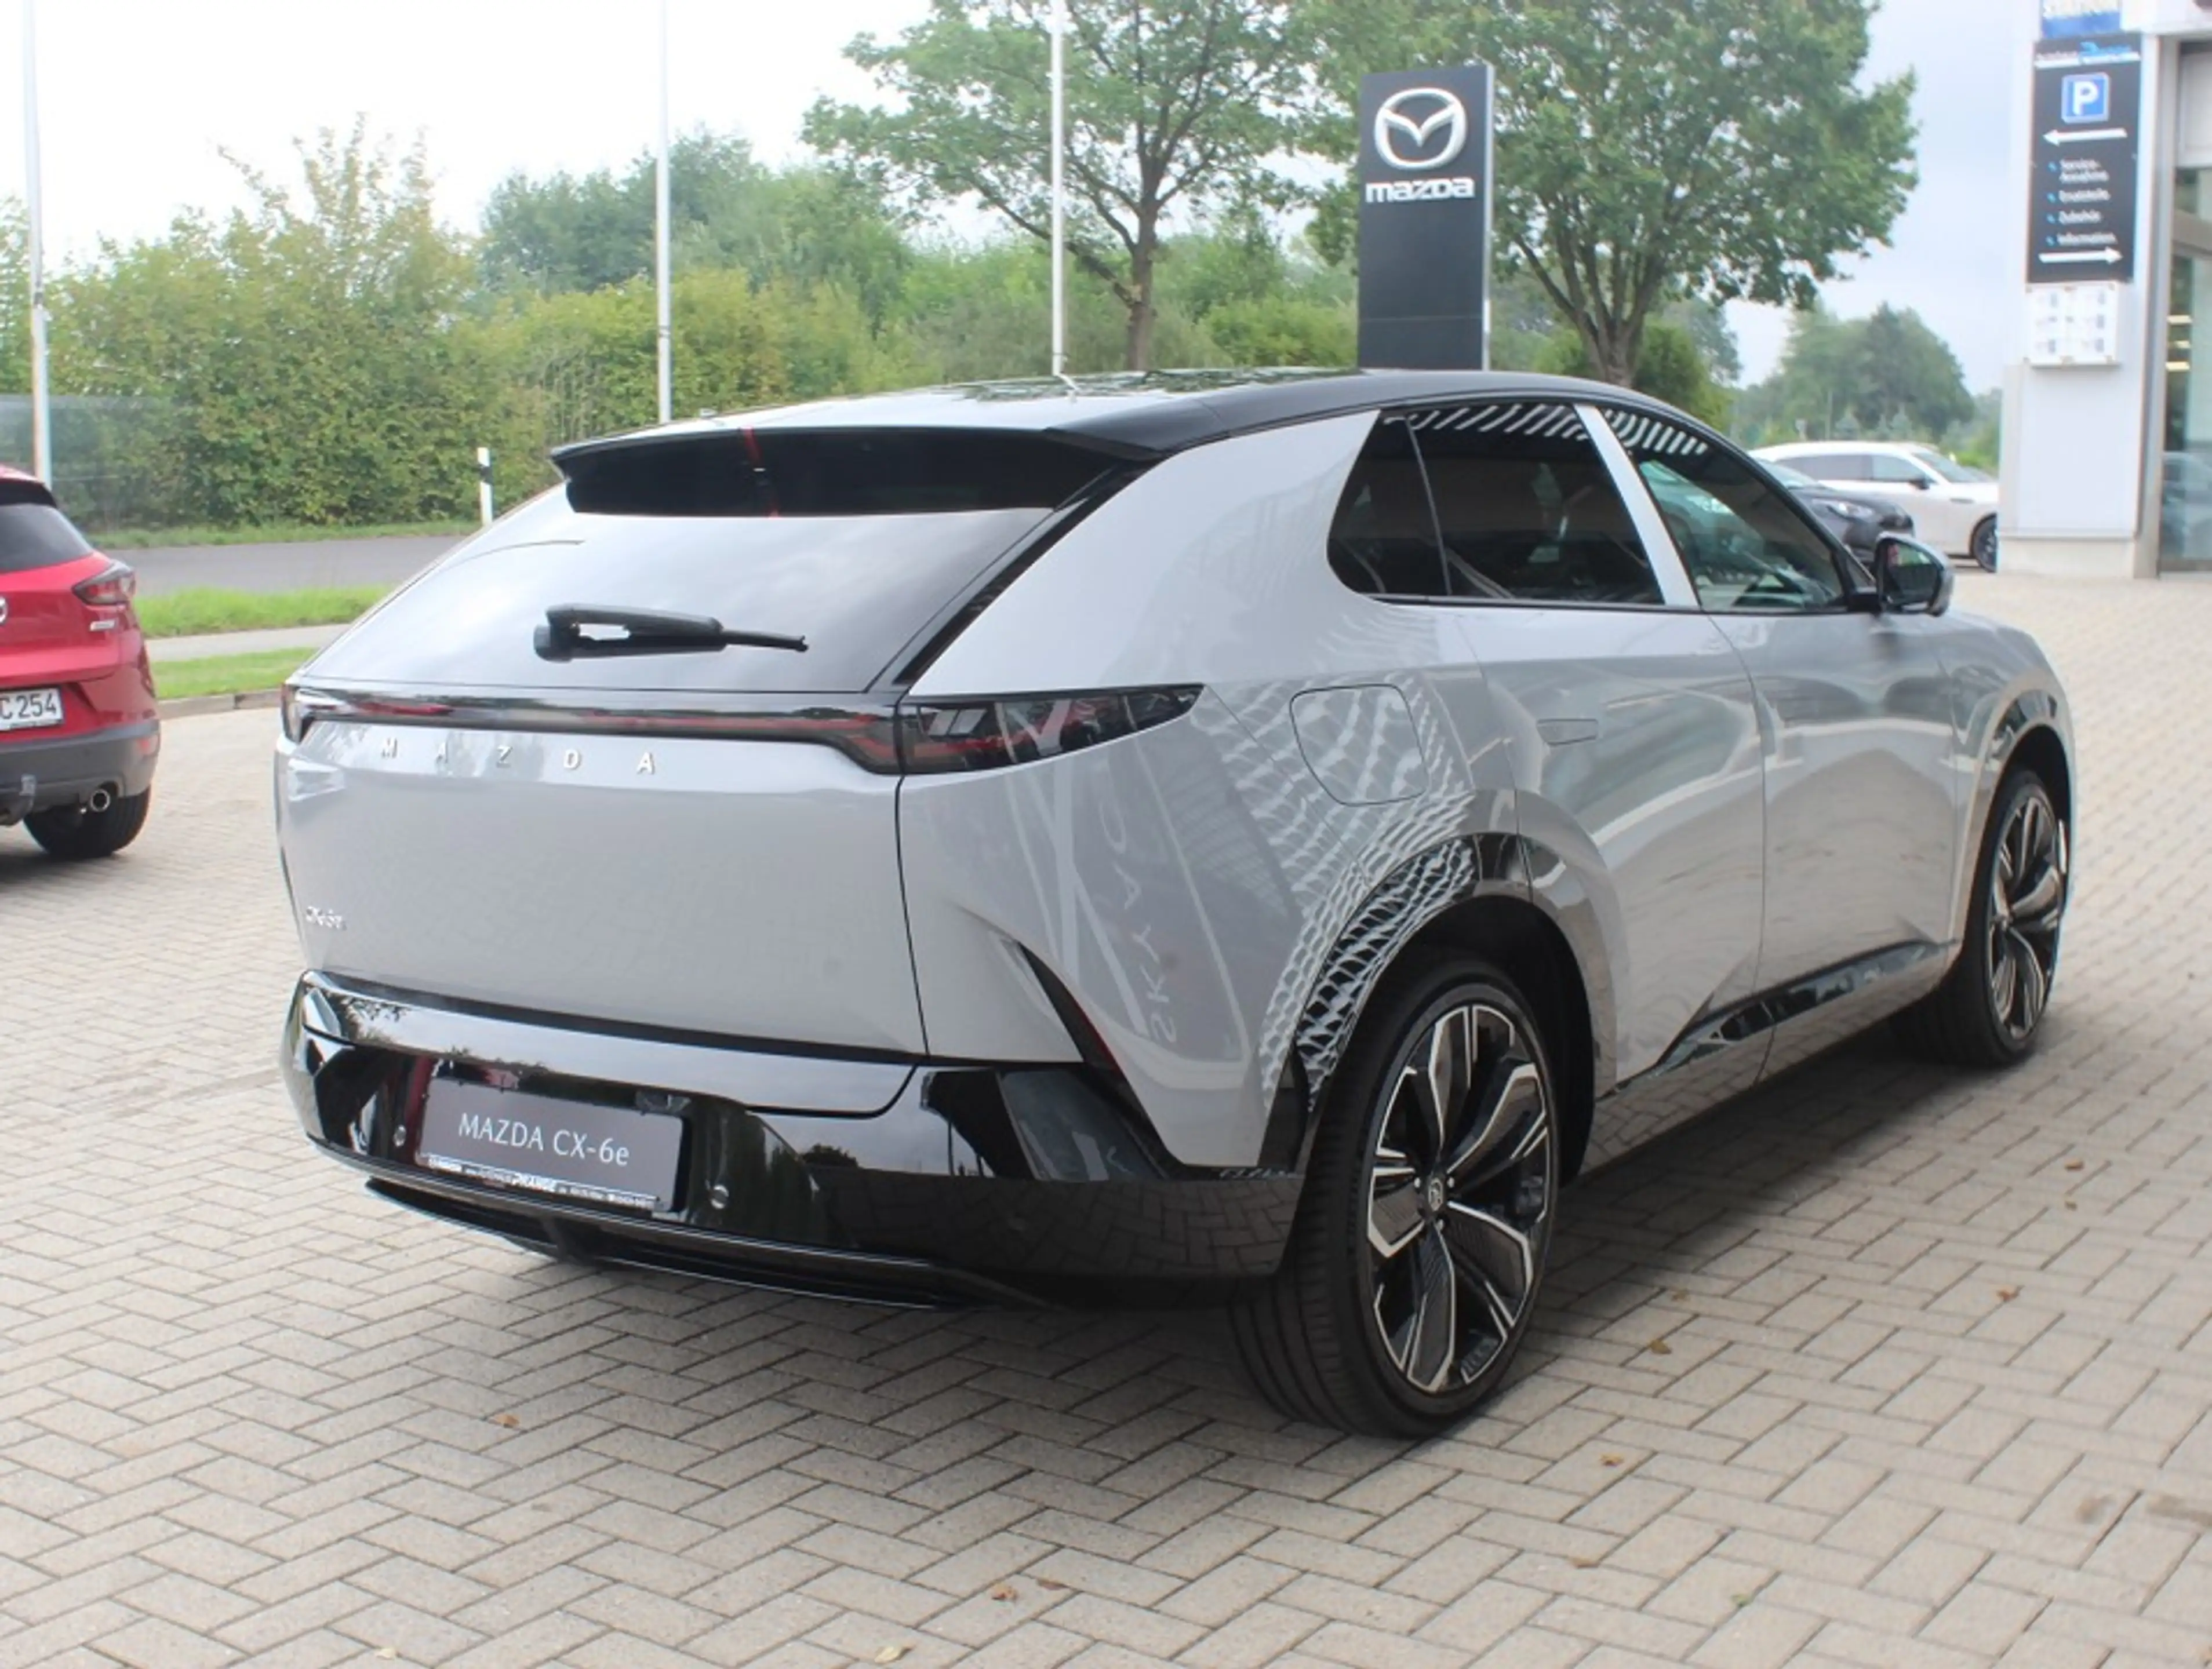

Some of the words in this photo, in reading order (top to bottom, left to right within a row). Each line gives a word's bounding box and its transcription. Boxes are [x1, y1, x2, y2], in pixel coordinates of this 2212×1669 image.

[2072, 81, 2100, 116] P
[1365, 177, 1475, 203] mazda
[16, 693, 57, 719] 254
[381, 736, 655, 775] MAZDA
[459, 1112, 544, 1152] MAZDA
[553, 1129, 630, 1167] CX-6e
